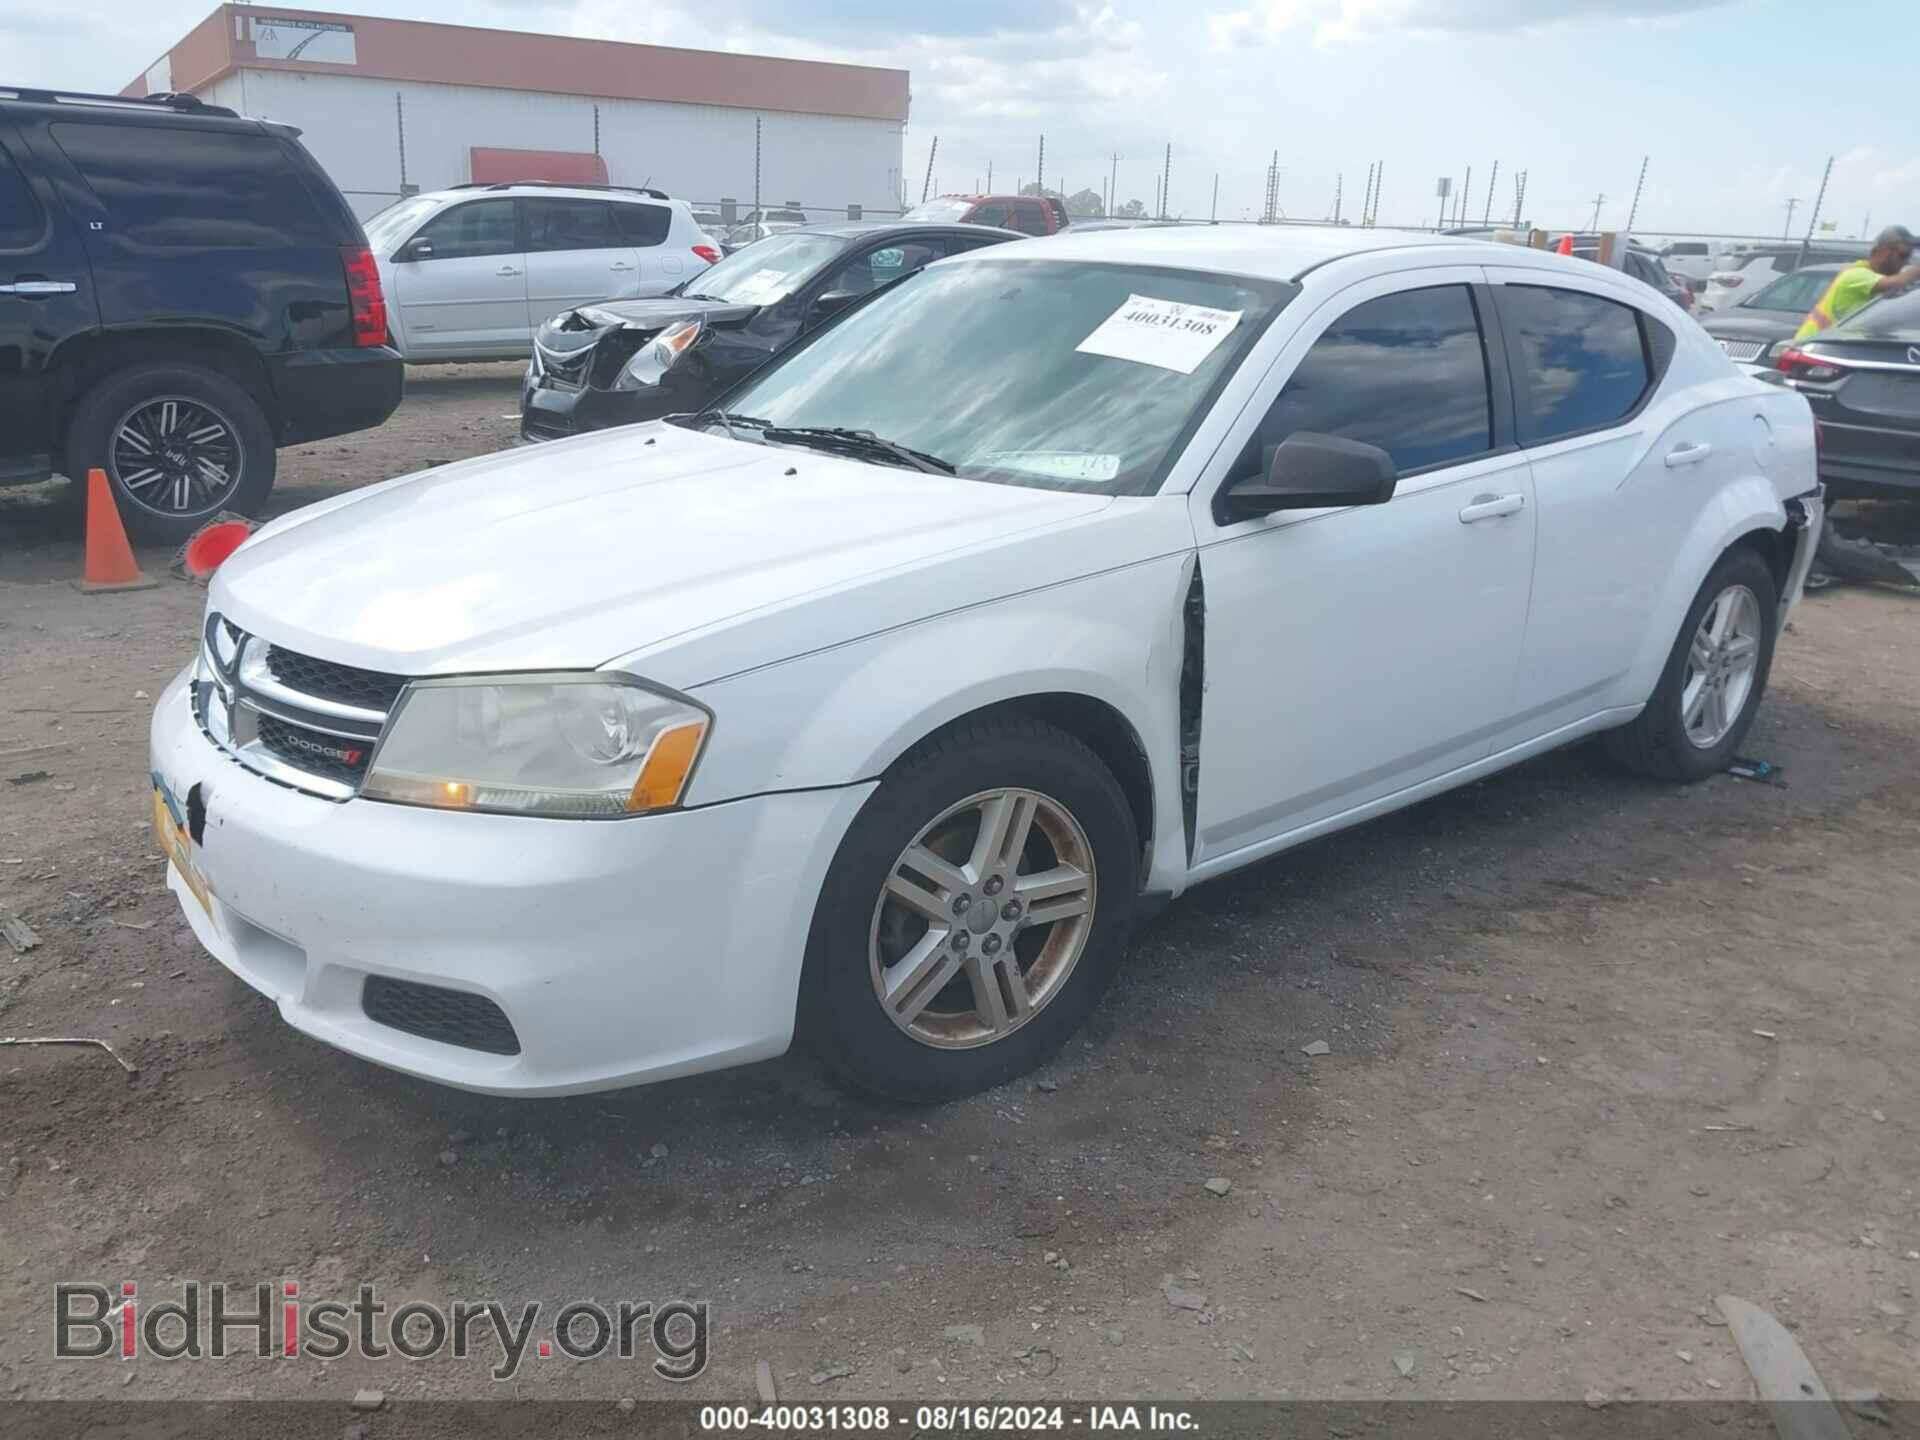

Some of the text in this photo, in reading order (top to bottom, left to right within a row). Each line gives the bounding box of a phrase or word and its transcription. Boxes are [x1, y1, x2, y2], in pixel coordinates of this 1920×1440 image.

[90, 222, 103, 230] LT
[1124, 311, 1218, 336] 40031308
[288, 736, 350, 761] DODGE
